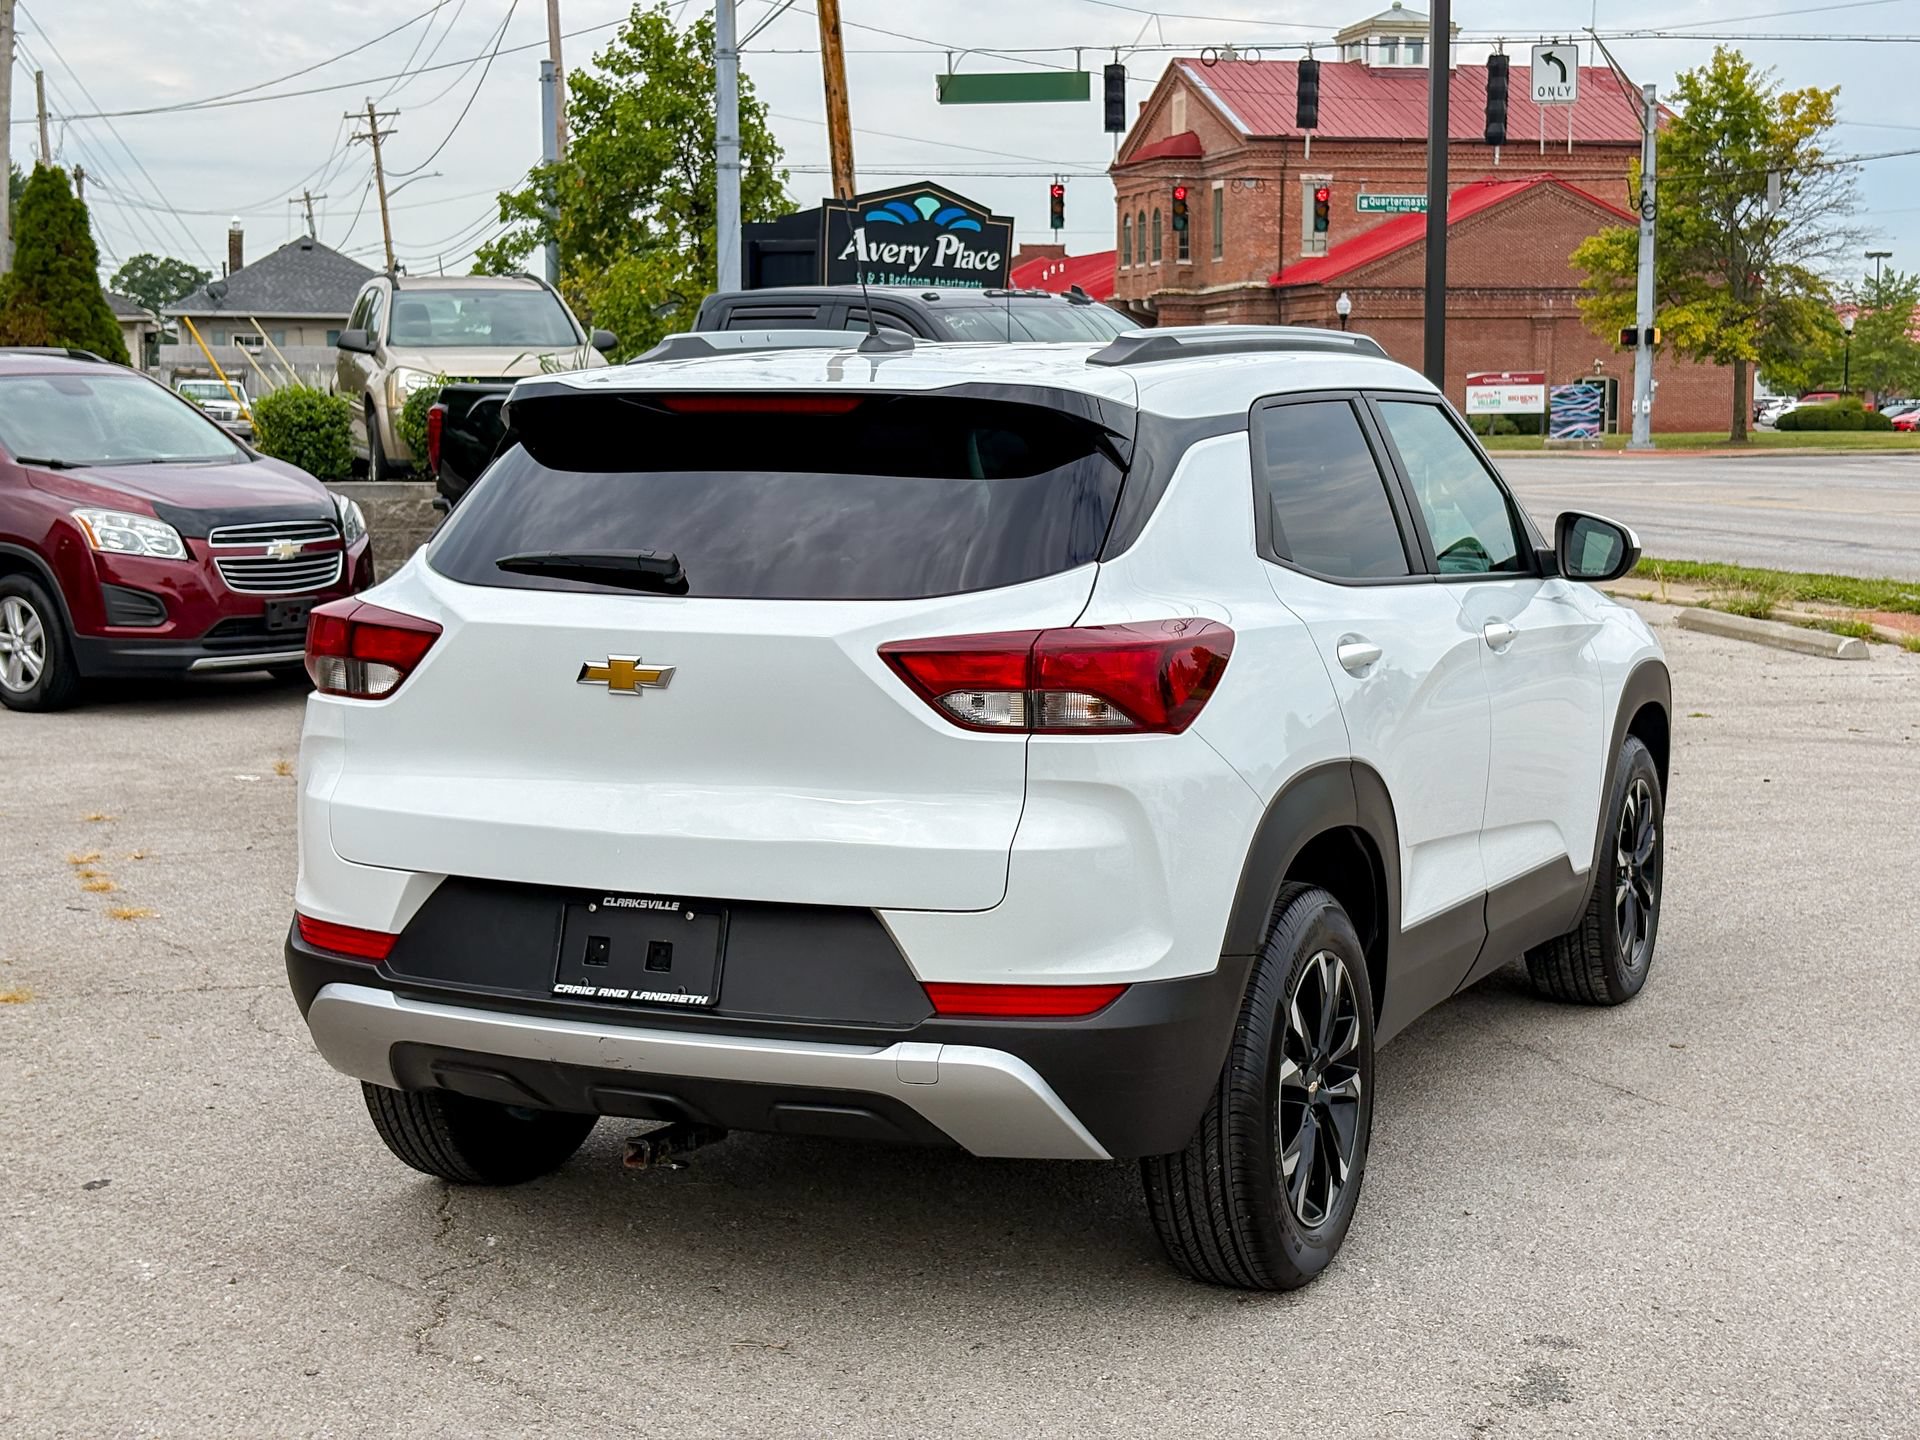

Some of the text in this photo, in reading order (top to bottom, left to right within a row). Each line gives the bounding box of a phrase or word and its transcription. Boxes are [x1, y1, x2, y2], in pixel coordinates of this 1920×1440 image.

[1537, 86, 1571, 97] ONLY
[837, 227, 1001, 273] Avery Place
[879, 274, 885, 285] 3
[889, 273, 931, 287] Bedroom
[602, 897, 680, 911] CLARKSVILLE
[553, 984, 709, 1005] CRAIG AND LANDRETH
